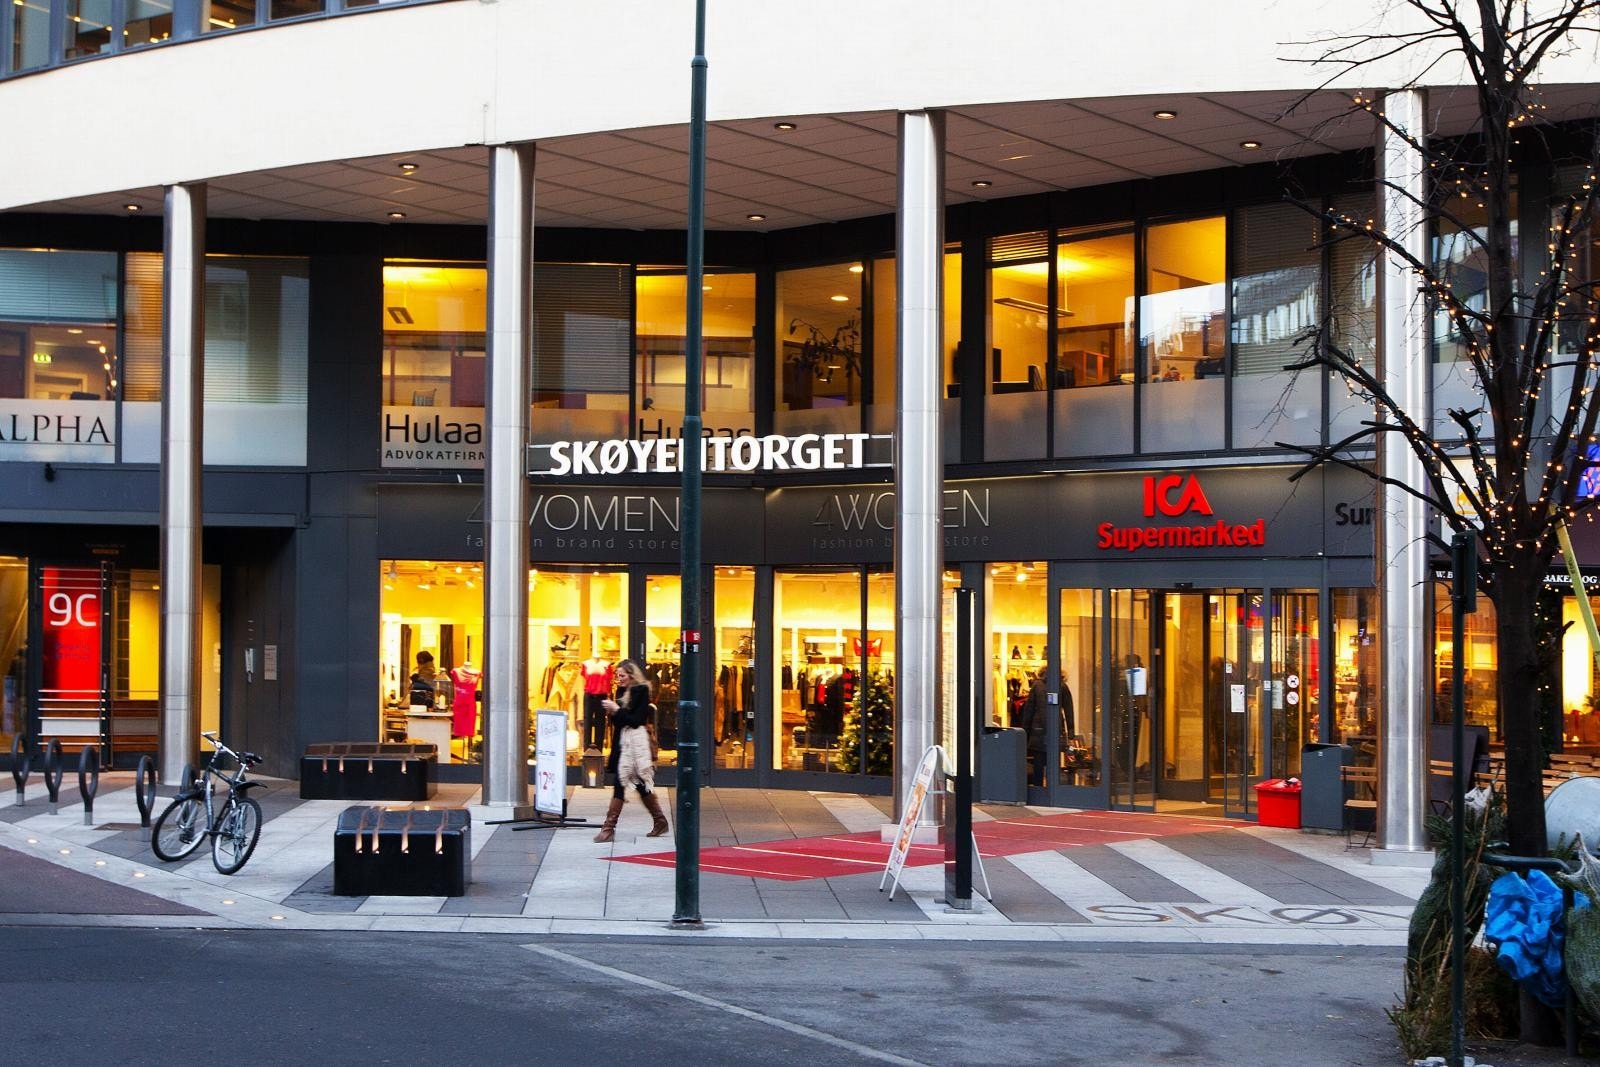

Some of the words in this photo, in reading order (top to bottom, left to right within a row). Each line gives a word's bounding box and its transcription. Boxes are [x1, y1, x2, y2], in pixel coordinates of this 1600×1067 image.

[0, 414, 112, 443] LPHA
[385, 414, 482, 444] Hulaa
[385, 451, 485, 460] ADVOKATFIRM
[810, 488, 990, 531] 4WOEN
[1143, 473, 1214, 517] ICA
[556, 537, 615, 549] brand
[628, 538, 681, 550] store
[945, 534, 991, 547] store
[1097, 518, 1266, 551] Supermarked
[1543, 574, 1573, 583] BAKE
[49, 592, 97, 627] 9C
[1086, 903, 1412, 926] SKØ
